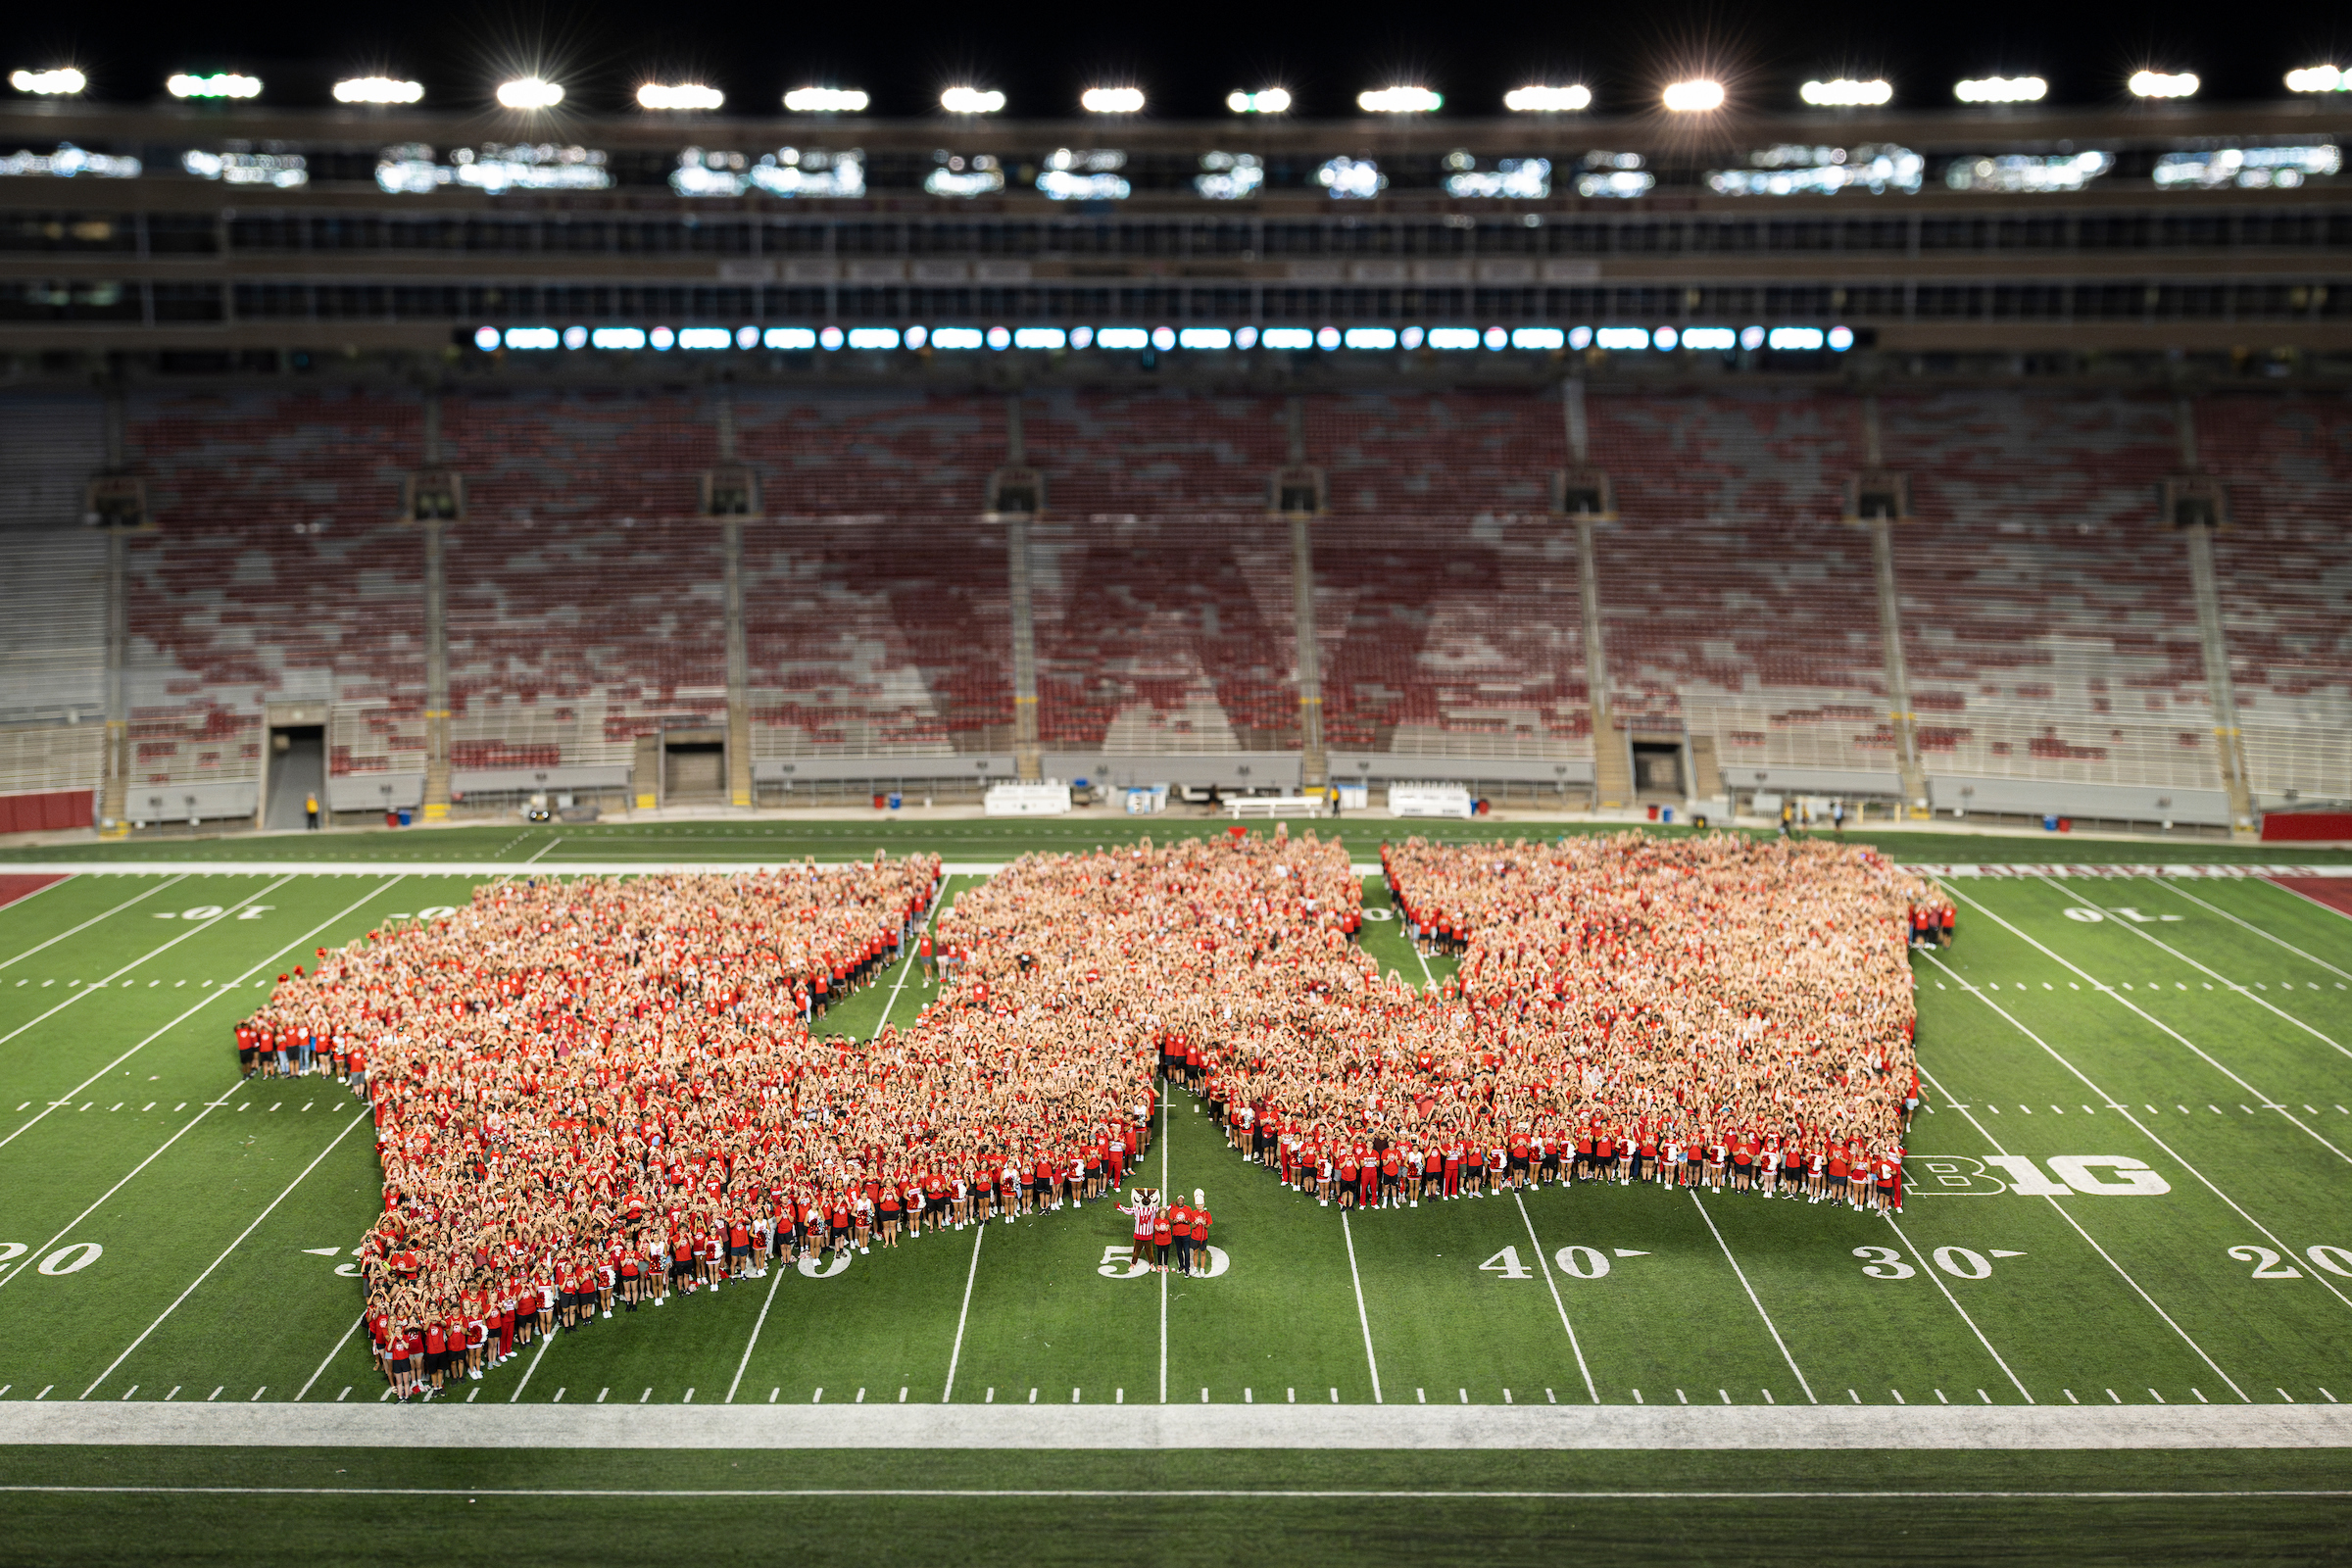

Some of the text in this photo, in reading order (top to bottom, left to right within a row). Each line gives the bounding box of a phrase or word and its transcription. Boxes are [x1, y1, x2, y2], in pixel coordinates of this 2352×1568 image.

[1098, 1246, 1230, 1279] 50
[1479, 1245, 1610, 1279] 40
[1852, 1246, 1992, 1280] 30
[2228, 1245, 2352, 1279] 20
